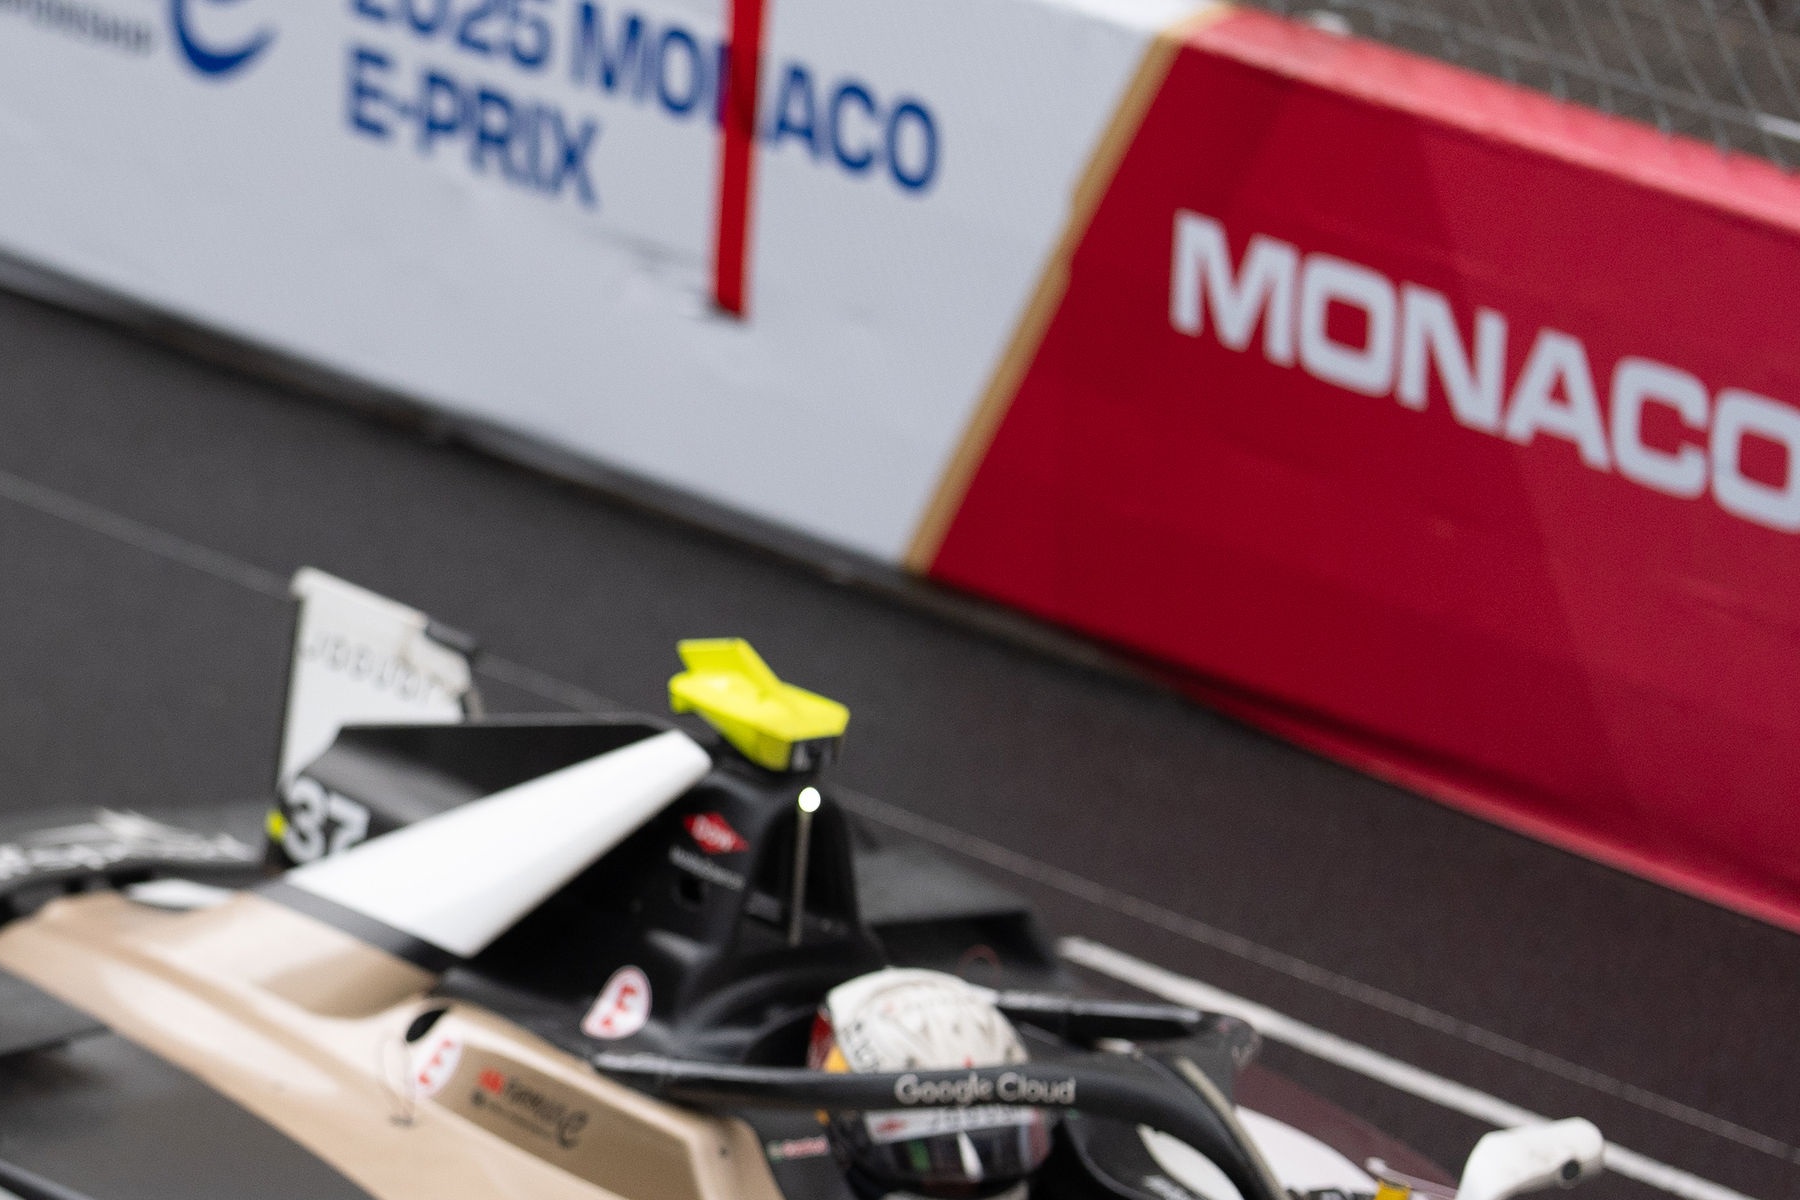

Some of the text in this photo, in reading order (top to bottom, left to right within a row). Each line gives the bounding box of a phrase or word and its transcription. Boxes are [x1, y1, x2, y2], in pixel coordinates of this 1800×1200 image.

[346, 44, 600, 208] E-PRIX
[570, 0, 940, 194] MOACO
[1169, 207, 1800, 534] MONACO
[282, 775, 370, 865] 37
[894, 1071, 1077, 1107] Google Cloud
